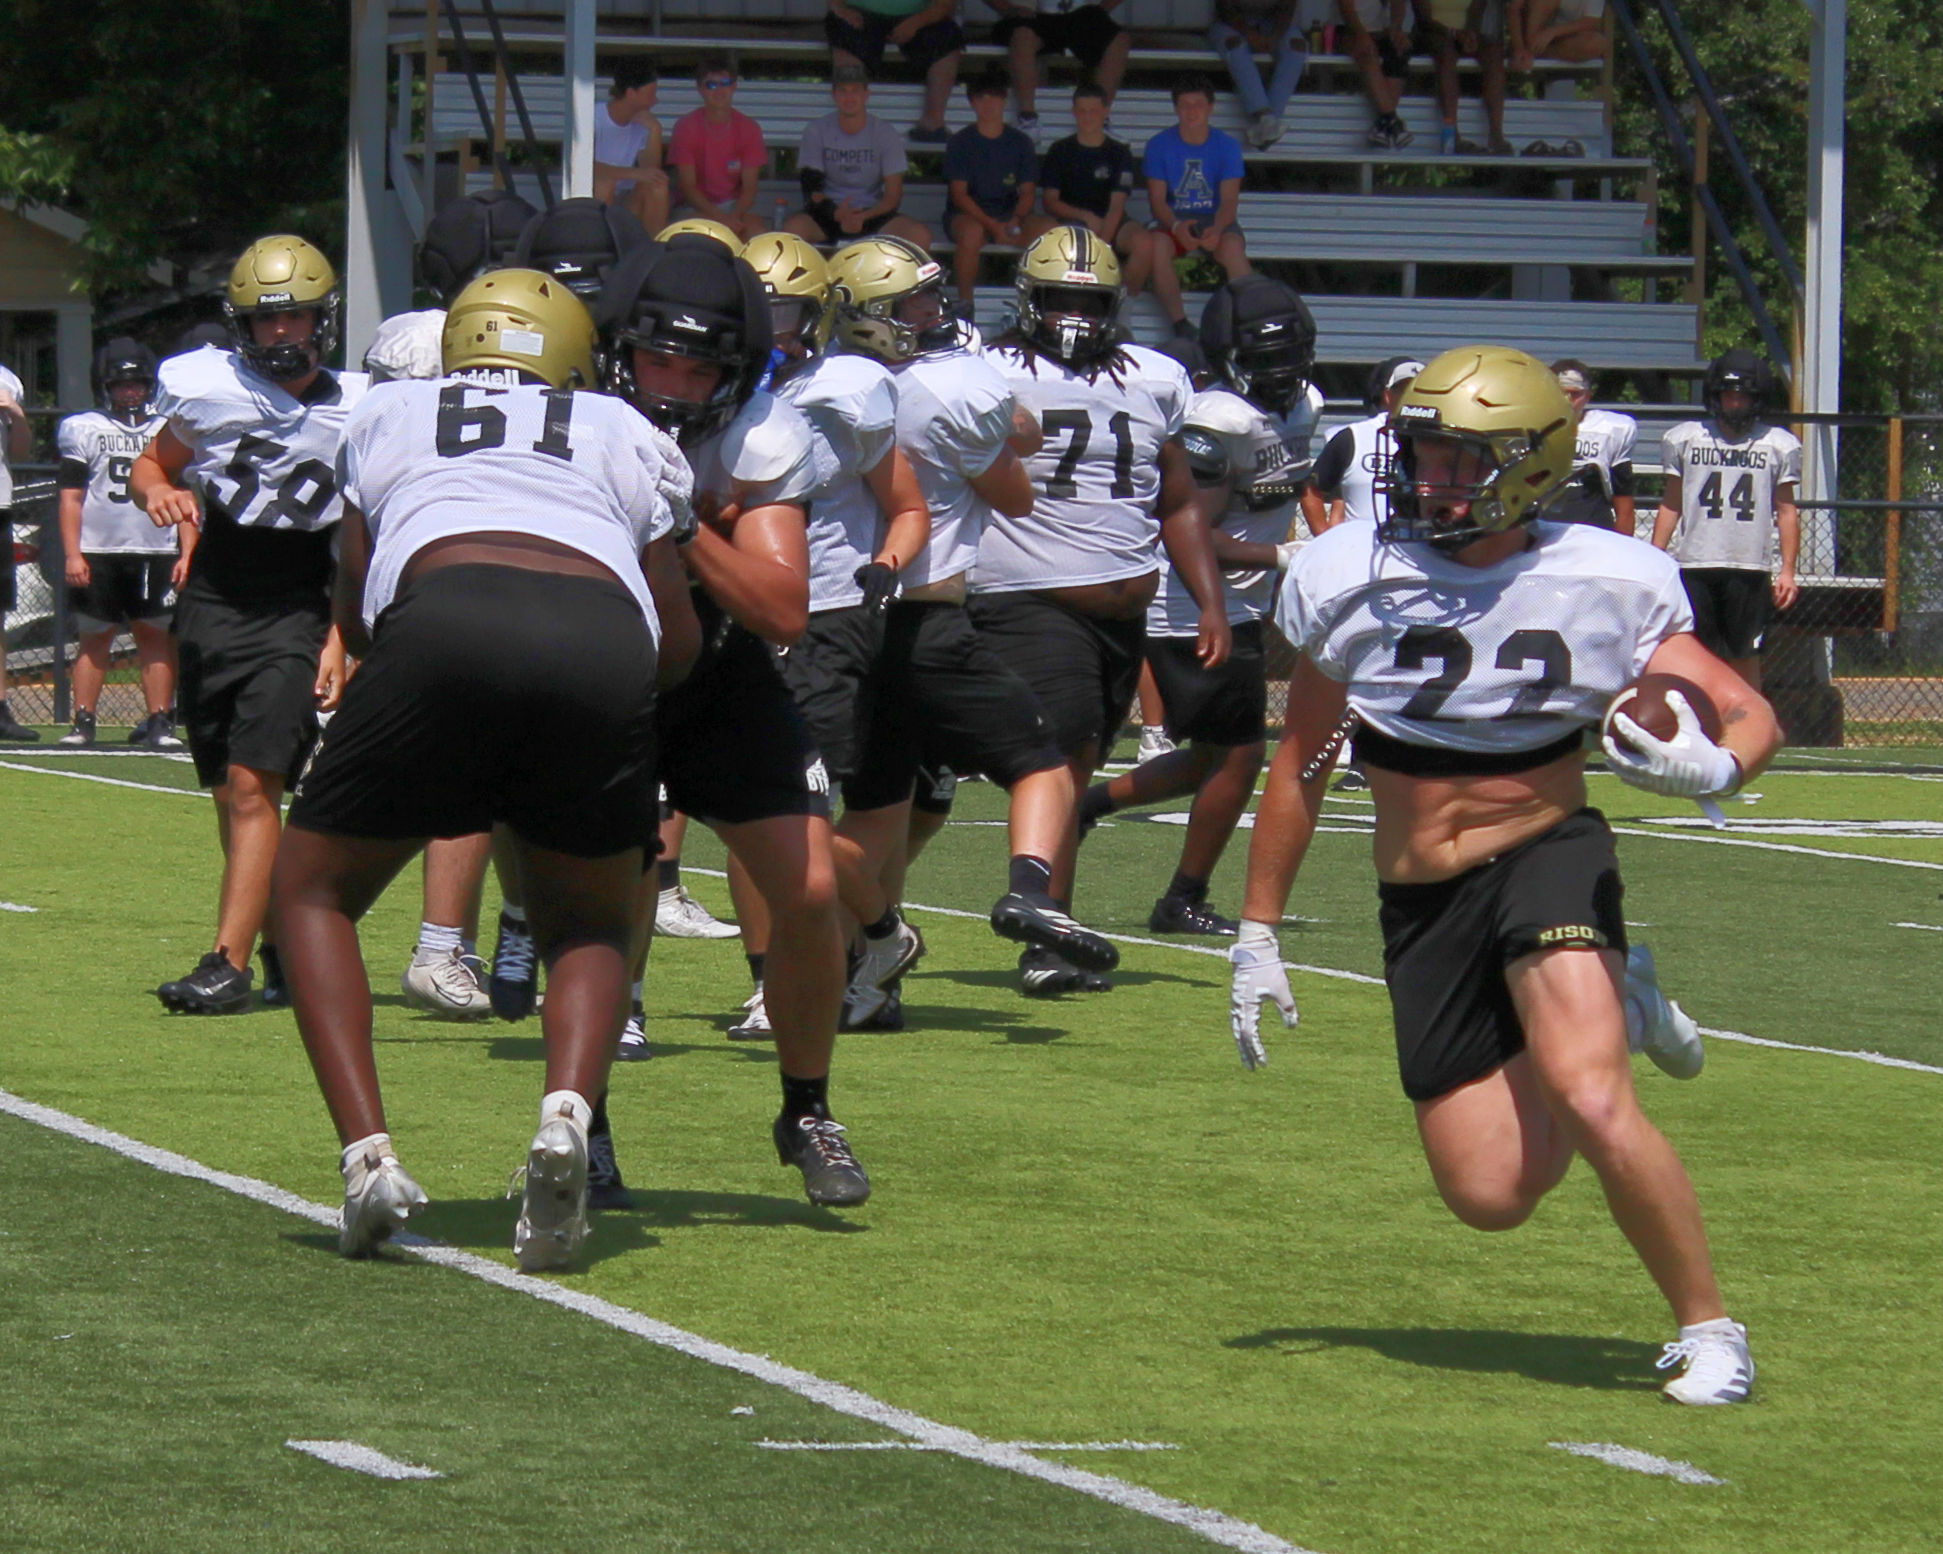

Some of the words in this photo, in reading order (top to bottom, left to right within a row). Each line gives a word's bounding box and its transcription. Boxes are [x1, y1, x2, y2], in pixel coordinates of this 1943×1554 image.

[486, 321, 498, 332] 61
[436, 382, 574, 462] 61
[1401, 405, 1437, 418] Riddell
[98, 434, 154, 453] BUCKAR
[1042, 409, 1135, 499] 71
[1699, 471, 1756, 521] 44
[1394, 625, 1571, 720] 22
